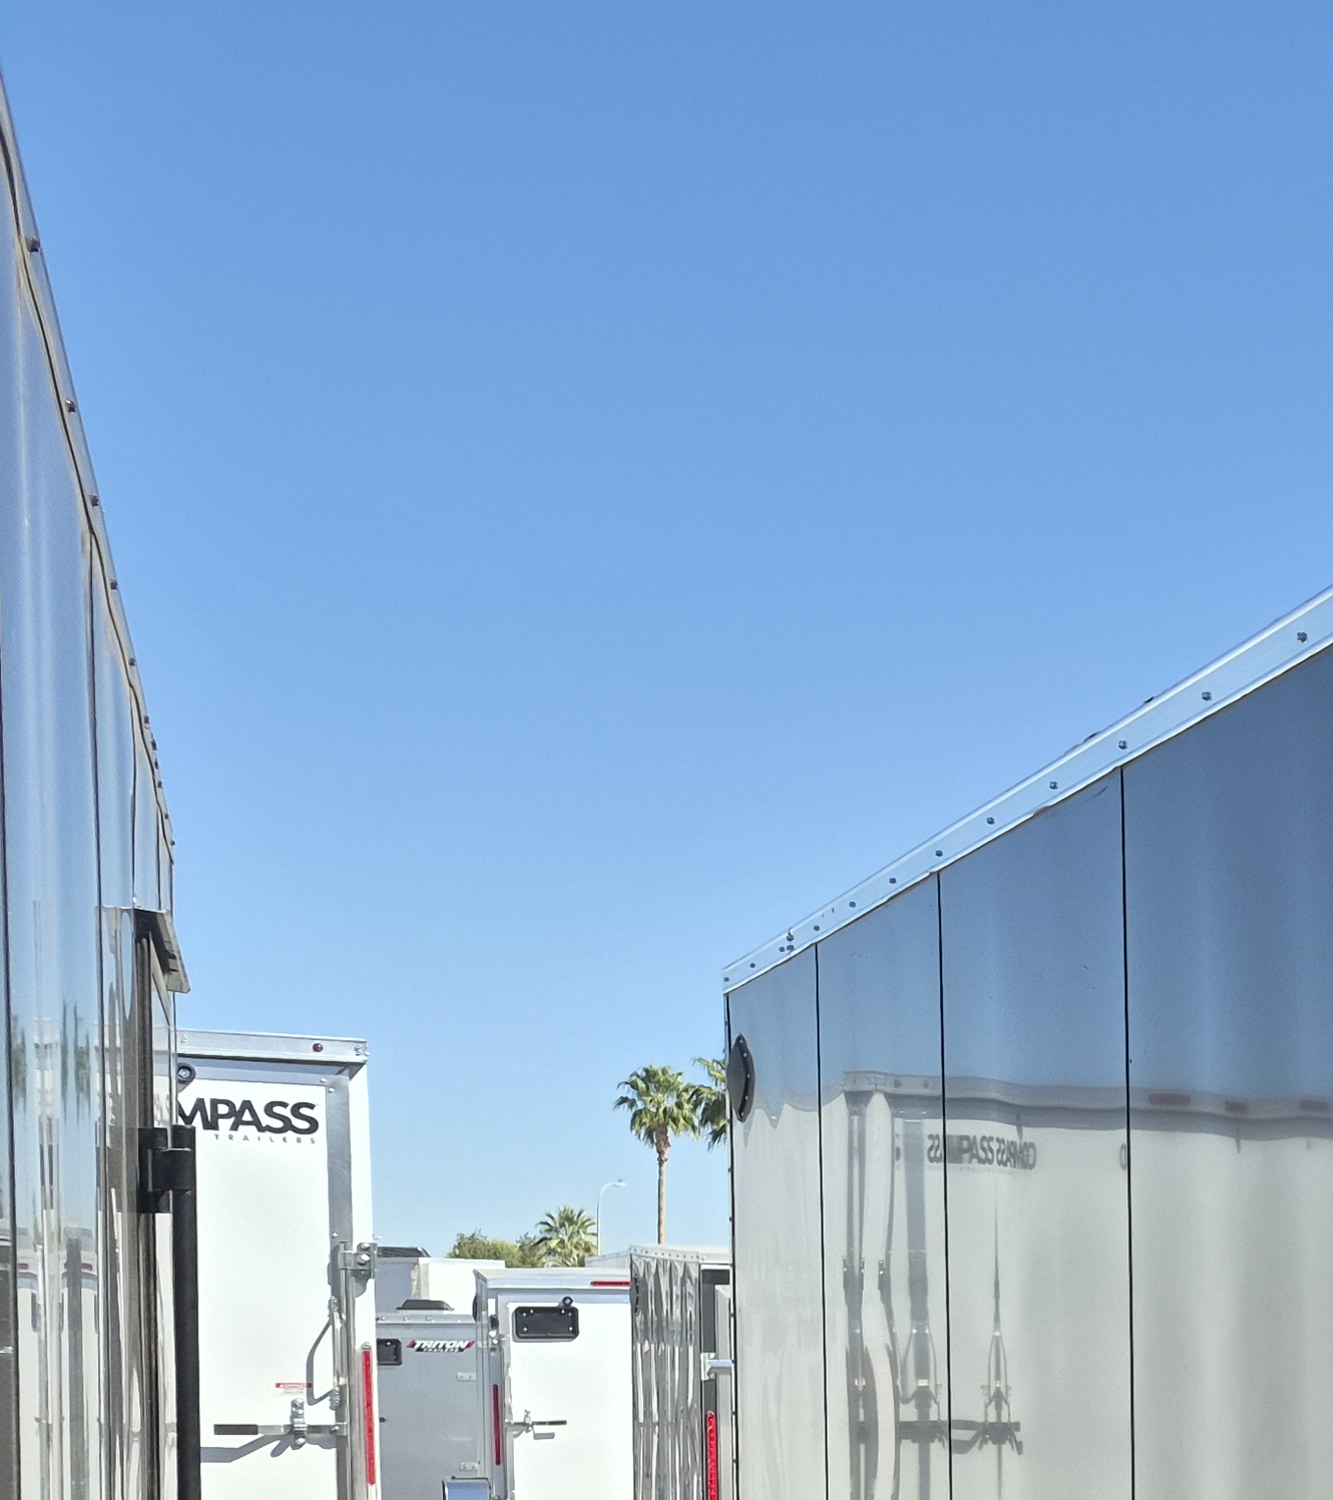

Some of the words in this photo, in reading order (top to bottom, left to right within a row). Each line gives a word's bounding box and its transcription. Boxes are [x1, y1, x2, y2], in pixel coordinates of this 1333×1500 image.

[178, 1097, 319, 1135] MPASS
[214, 1133, 316, 1145] TRAILERS
[413, 1340, 470, 1348] TRITON
